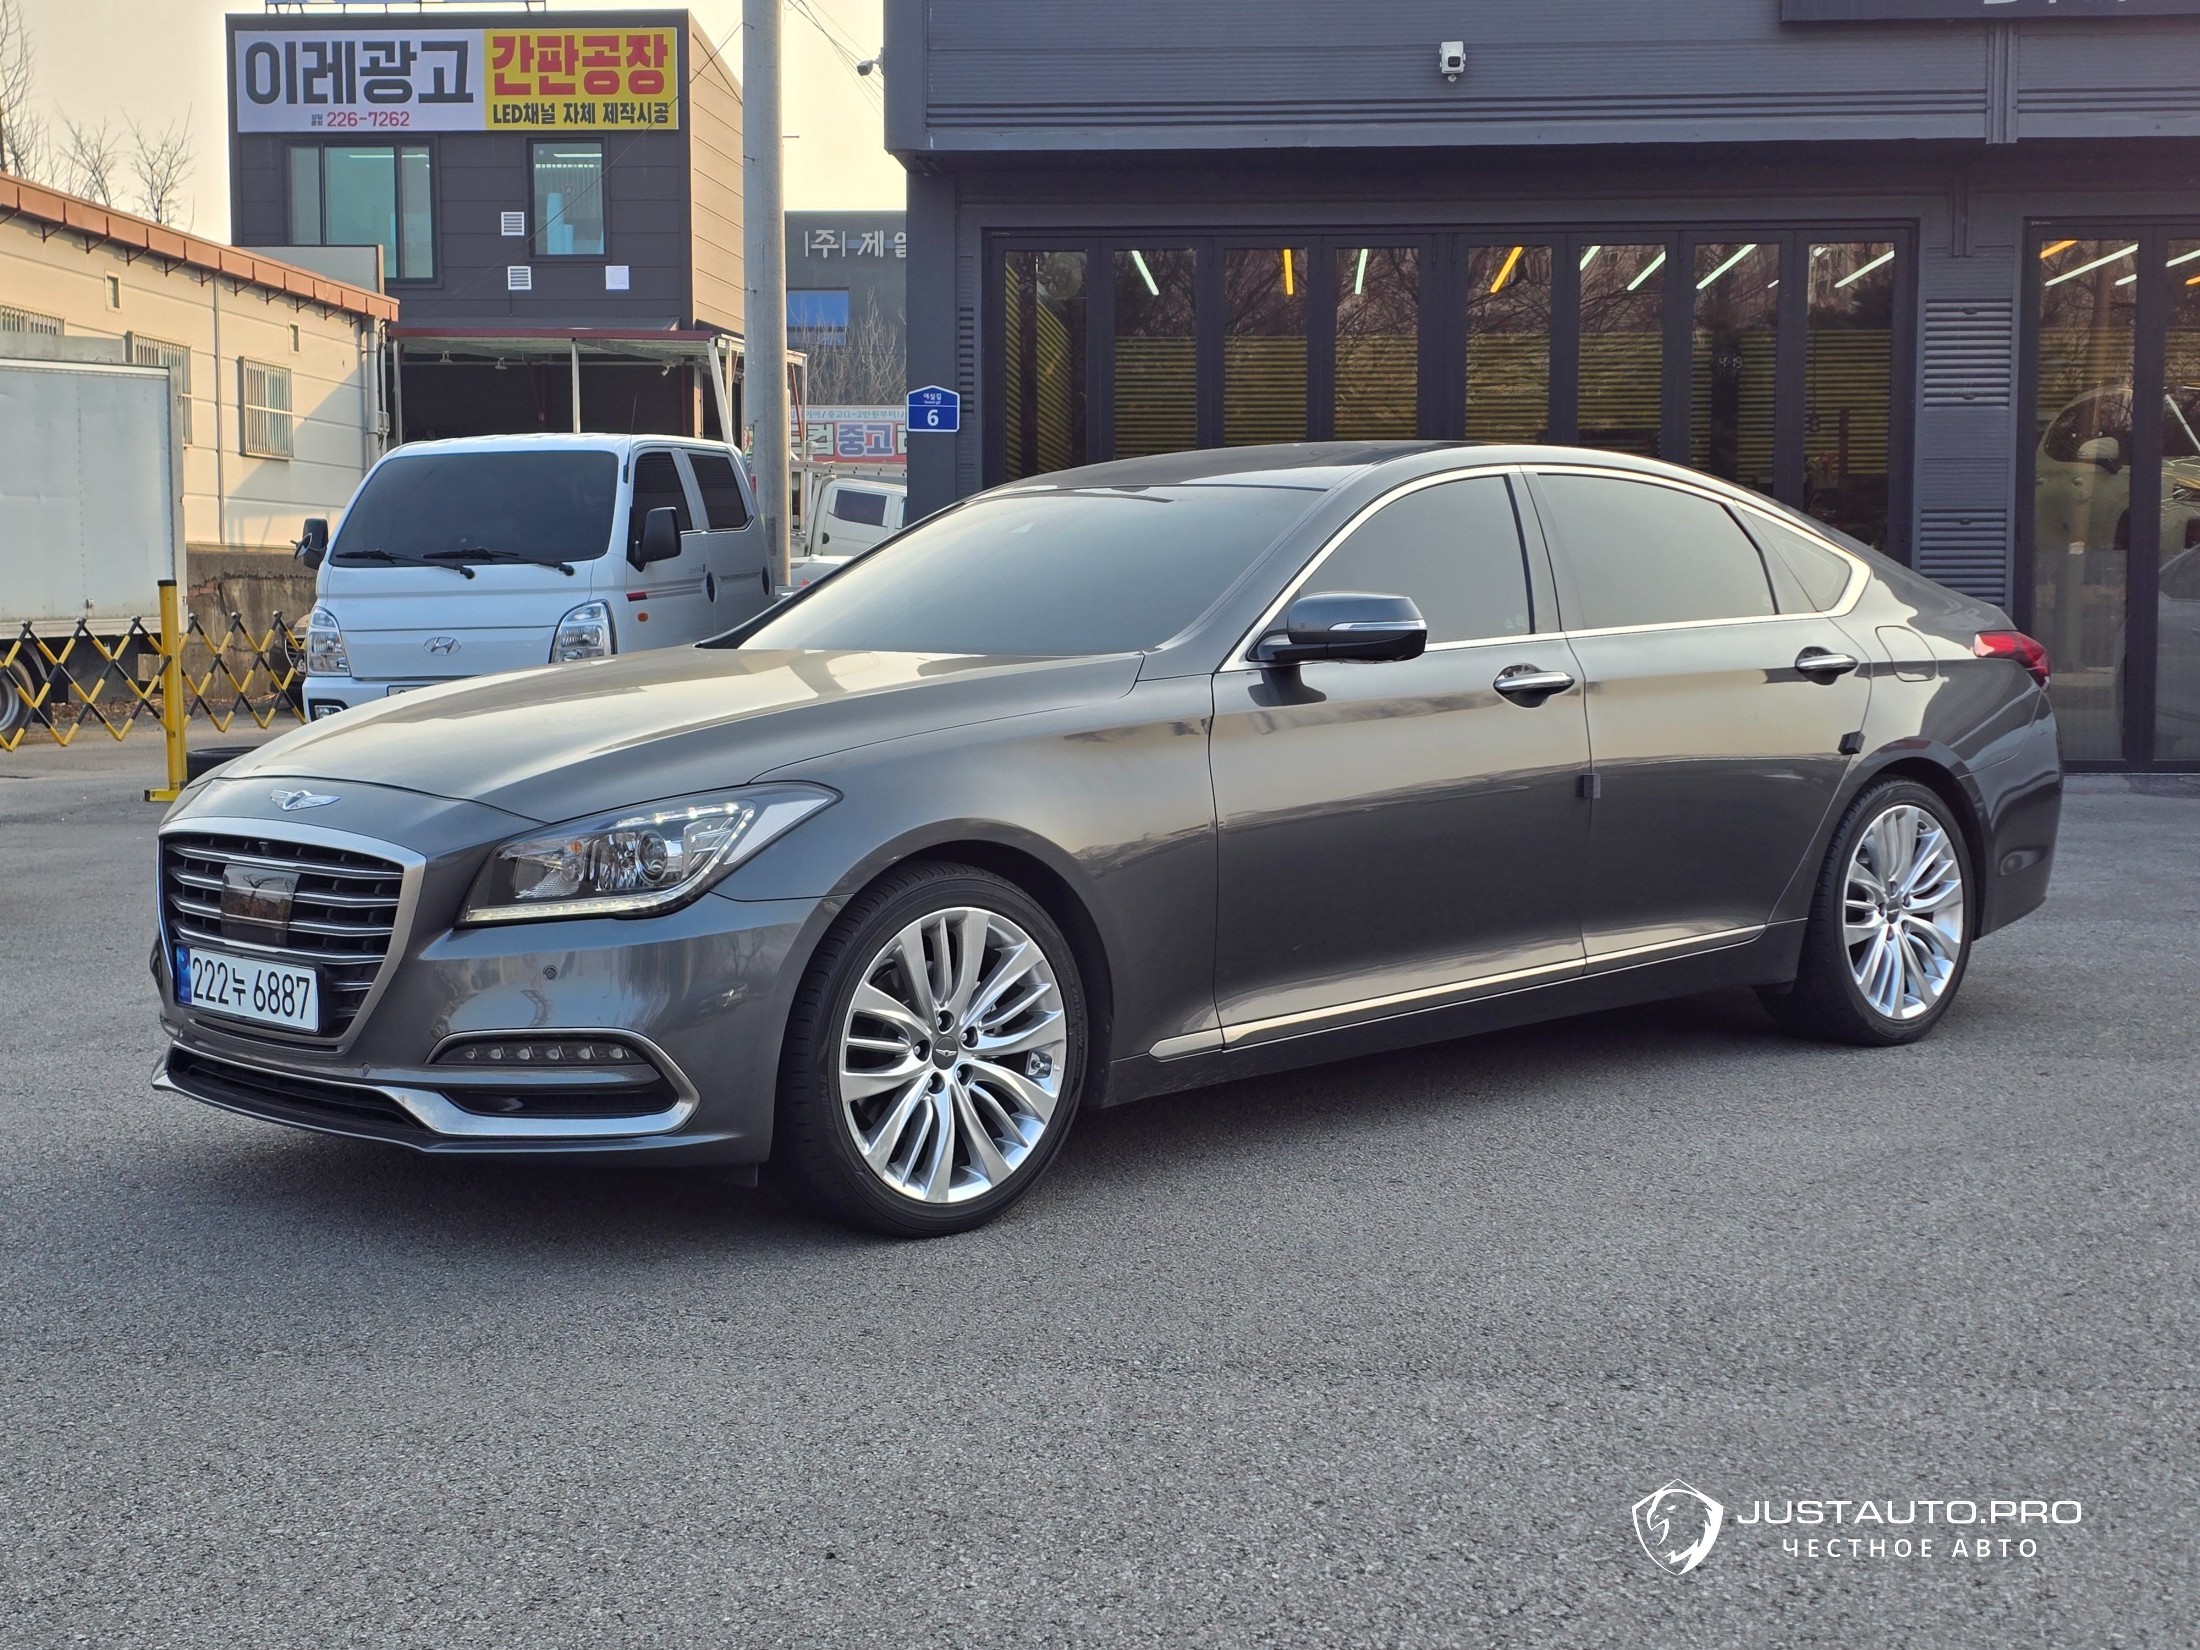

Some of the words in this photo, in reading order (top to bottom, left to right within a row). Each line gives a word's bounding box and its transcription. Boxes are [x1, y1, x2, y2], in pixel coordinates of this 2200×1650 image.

[245, 40, 474, 104] 이레광고
[492, 34, 668, 96] 간판공장
[327, 111, 410, 127] 226-7262
[493, 102, 556, 125] LED채널
[563, 102, 596, 124] 자체
[602, 102, 669, 124] 제작시공
[927, 409, 939, 426] 6
[837, 422, 895, 458] 중고
[192, 957, 247, 1006] 222누
[253, 969, 310, 1020] 6887
